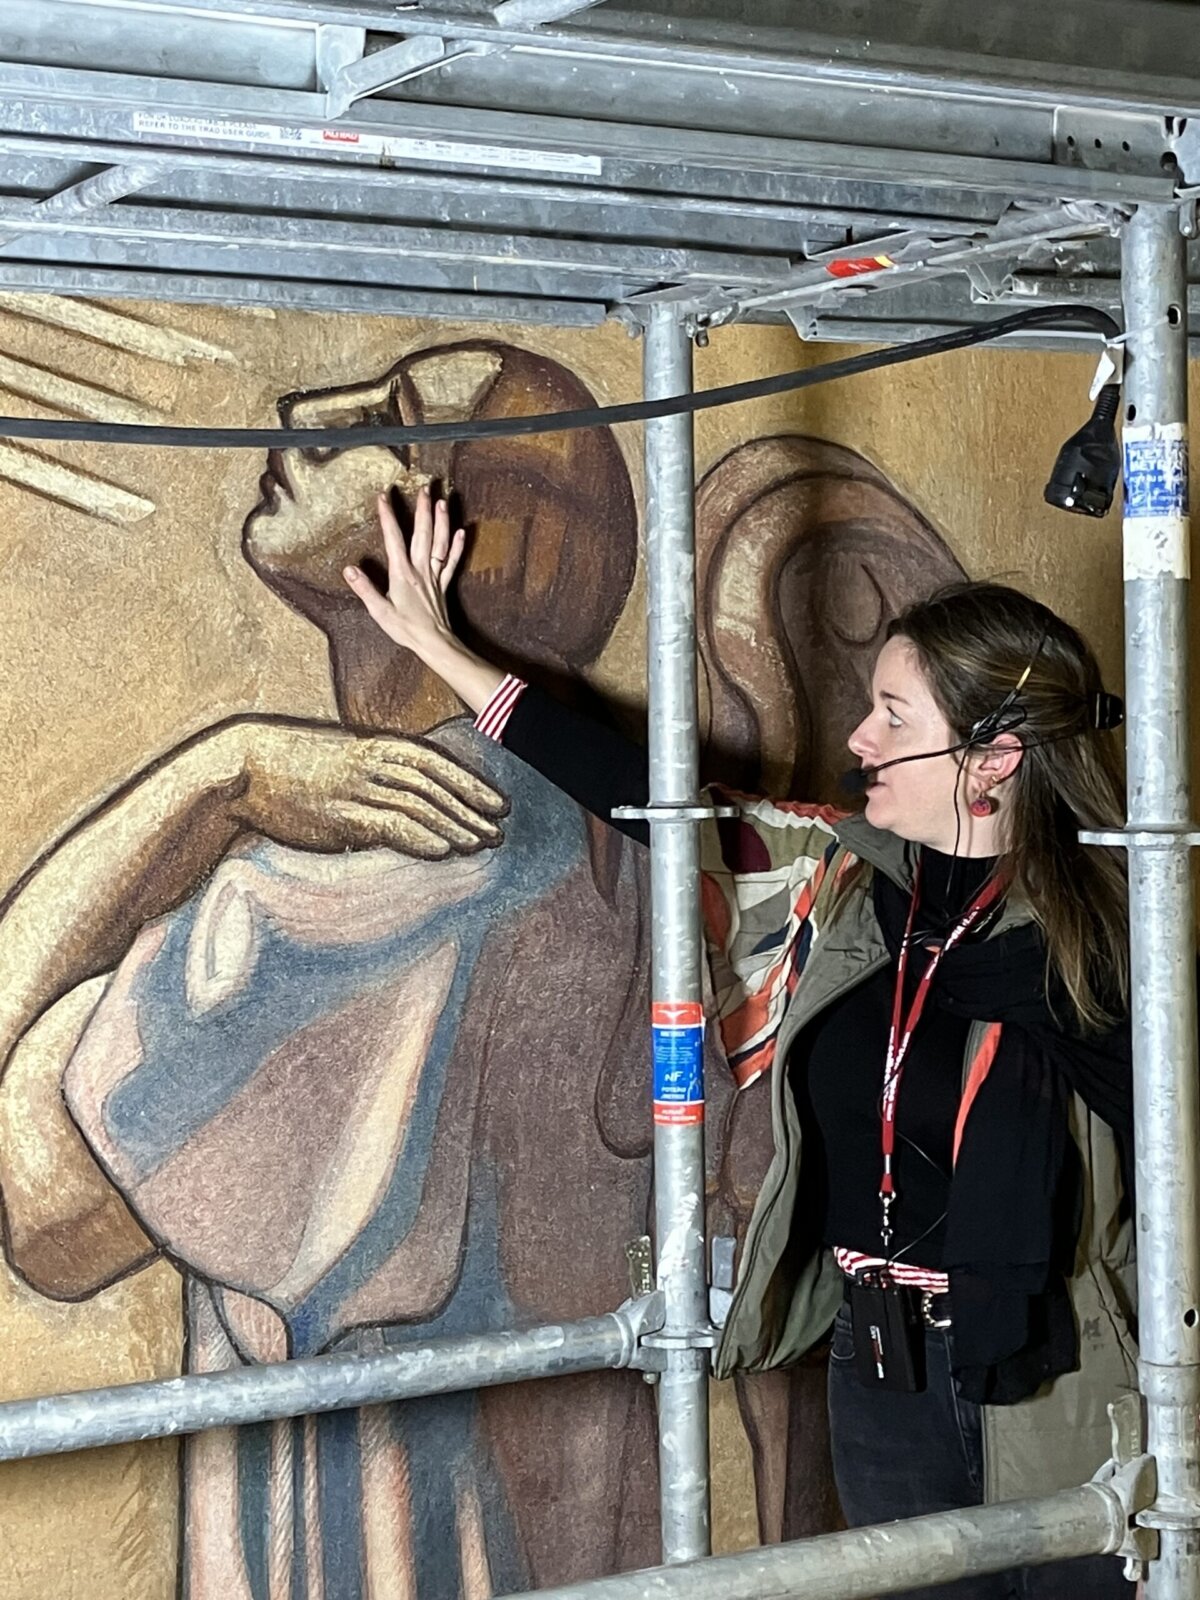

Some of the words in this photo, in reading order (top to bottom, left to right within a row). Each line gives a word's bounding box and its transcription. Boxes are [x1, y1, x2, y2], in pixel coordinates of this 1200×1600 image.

[138, 120, 166, 129] REFER
[168, 122, 179, 130] TO
[181, 124, 196, 132] THE
[222, 128, 244, 136] USER
[664, 1071, 684, 1082] NF
